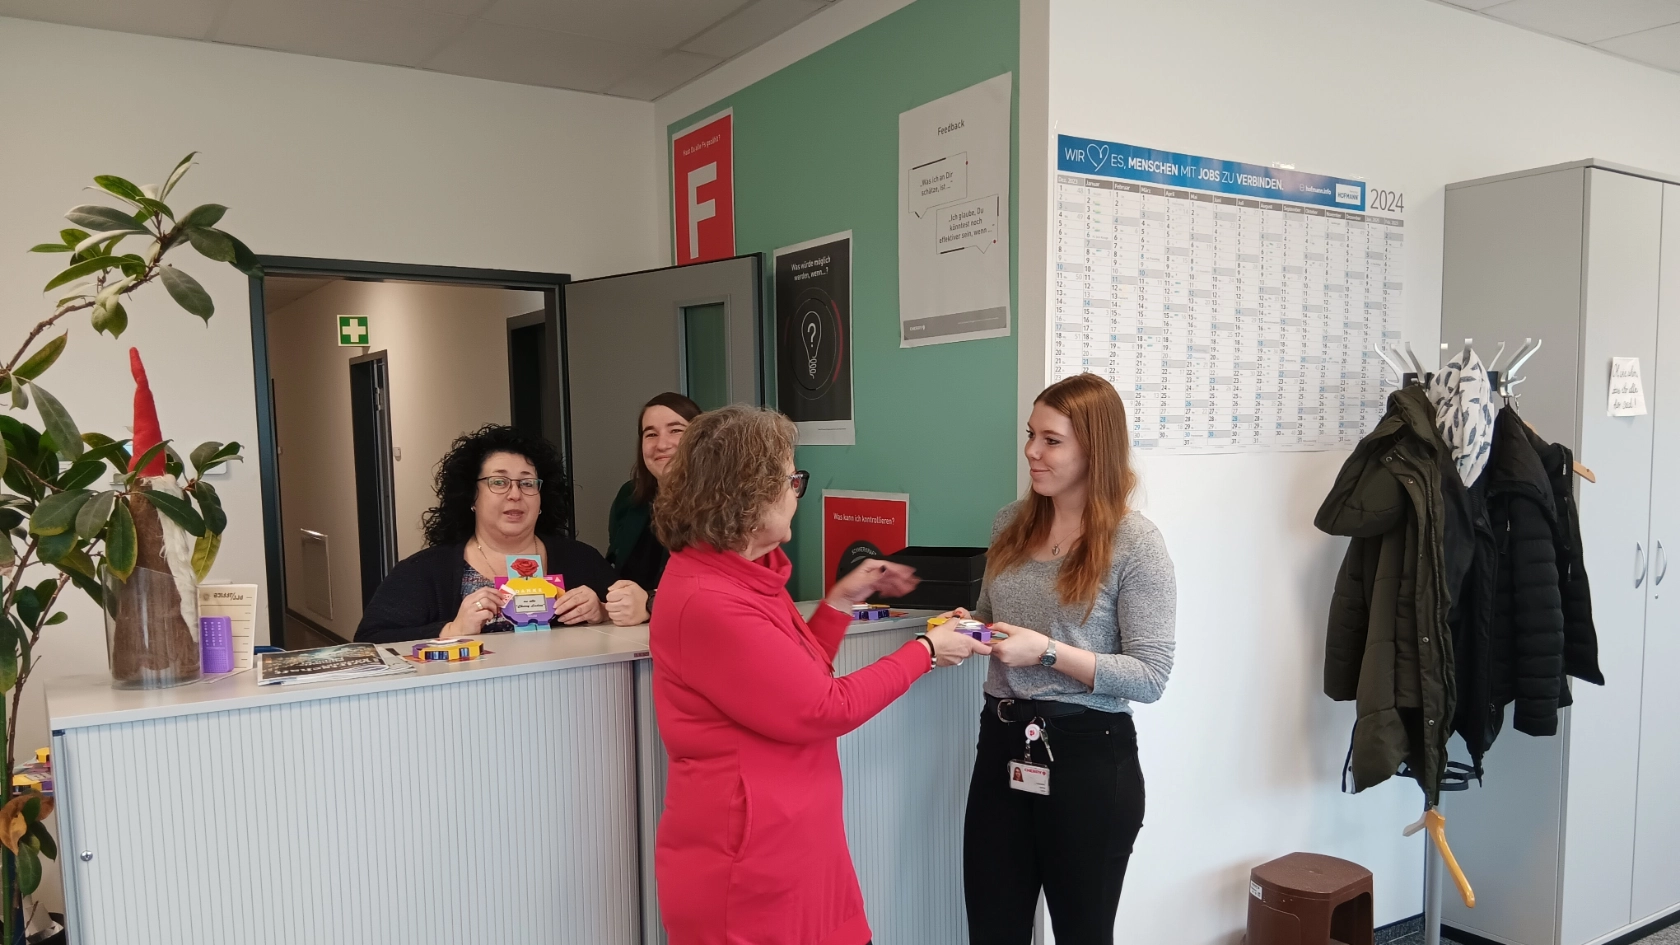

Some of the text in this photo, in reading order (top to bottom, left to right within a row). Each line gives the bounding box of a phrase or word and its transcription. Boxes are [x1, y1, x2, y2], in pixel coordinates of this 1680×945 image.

[938, 119, 965, 136] Feedback
[1064, 148, 1283, 190] WIR ES, MENSCHEN MIT JOBS ZU VERBINDEN.
[1338, 192, 1358, 200] HOFMANN
[1370, 188, 1404, 213] 2024
[688, 161, 717, 260] F
[950, 218, 982, 231] könntest noch
[939, 232, 961, 243] effektiver
[974, 228, 987, 236] wenn
[791, 255, 830, 272] Was würde möglich
[807, 322, 817, 348] ?
[833, 513, 843, 521] Was
[843, 514, 854, 522] kann
[862, 516, 895, 525] kontrollieren?
